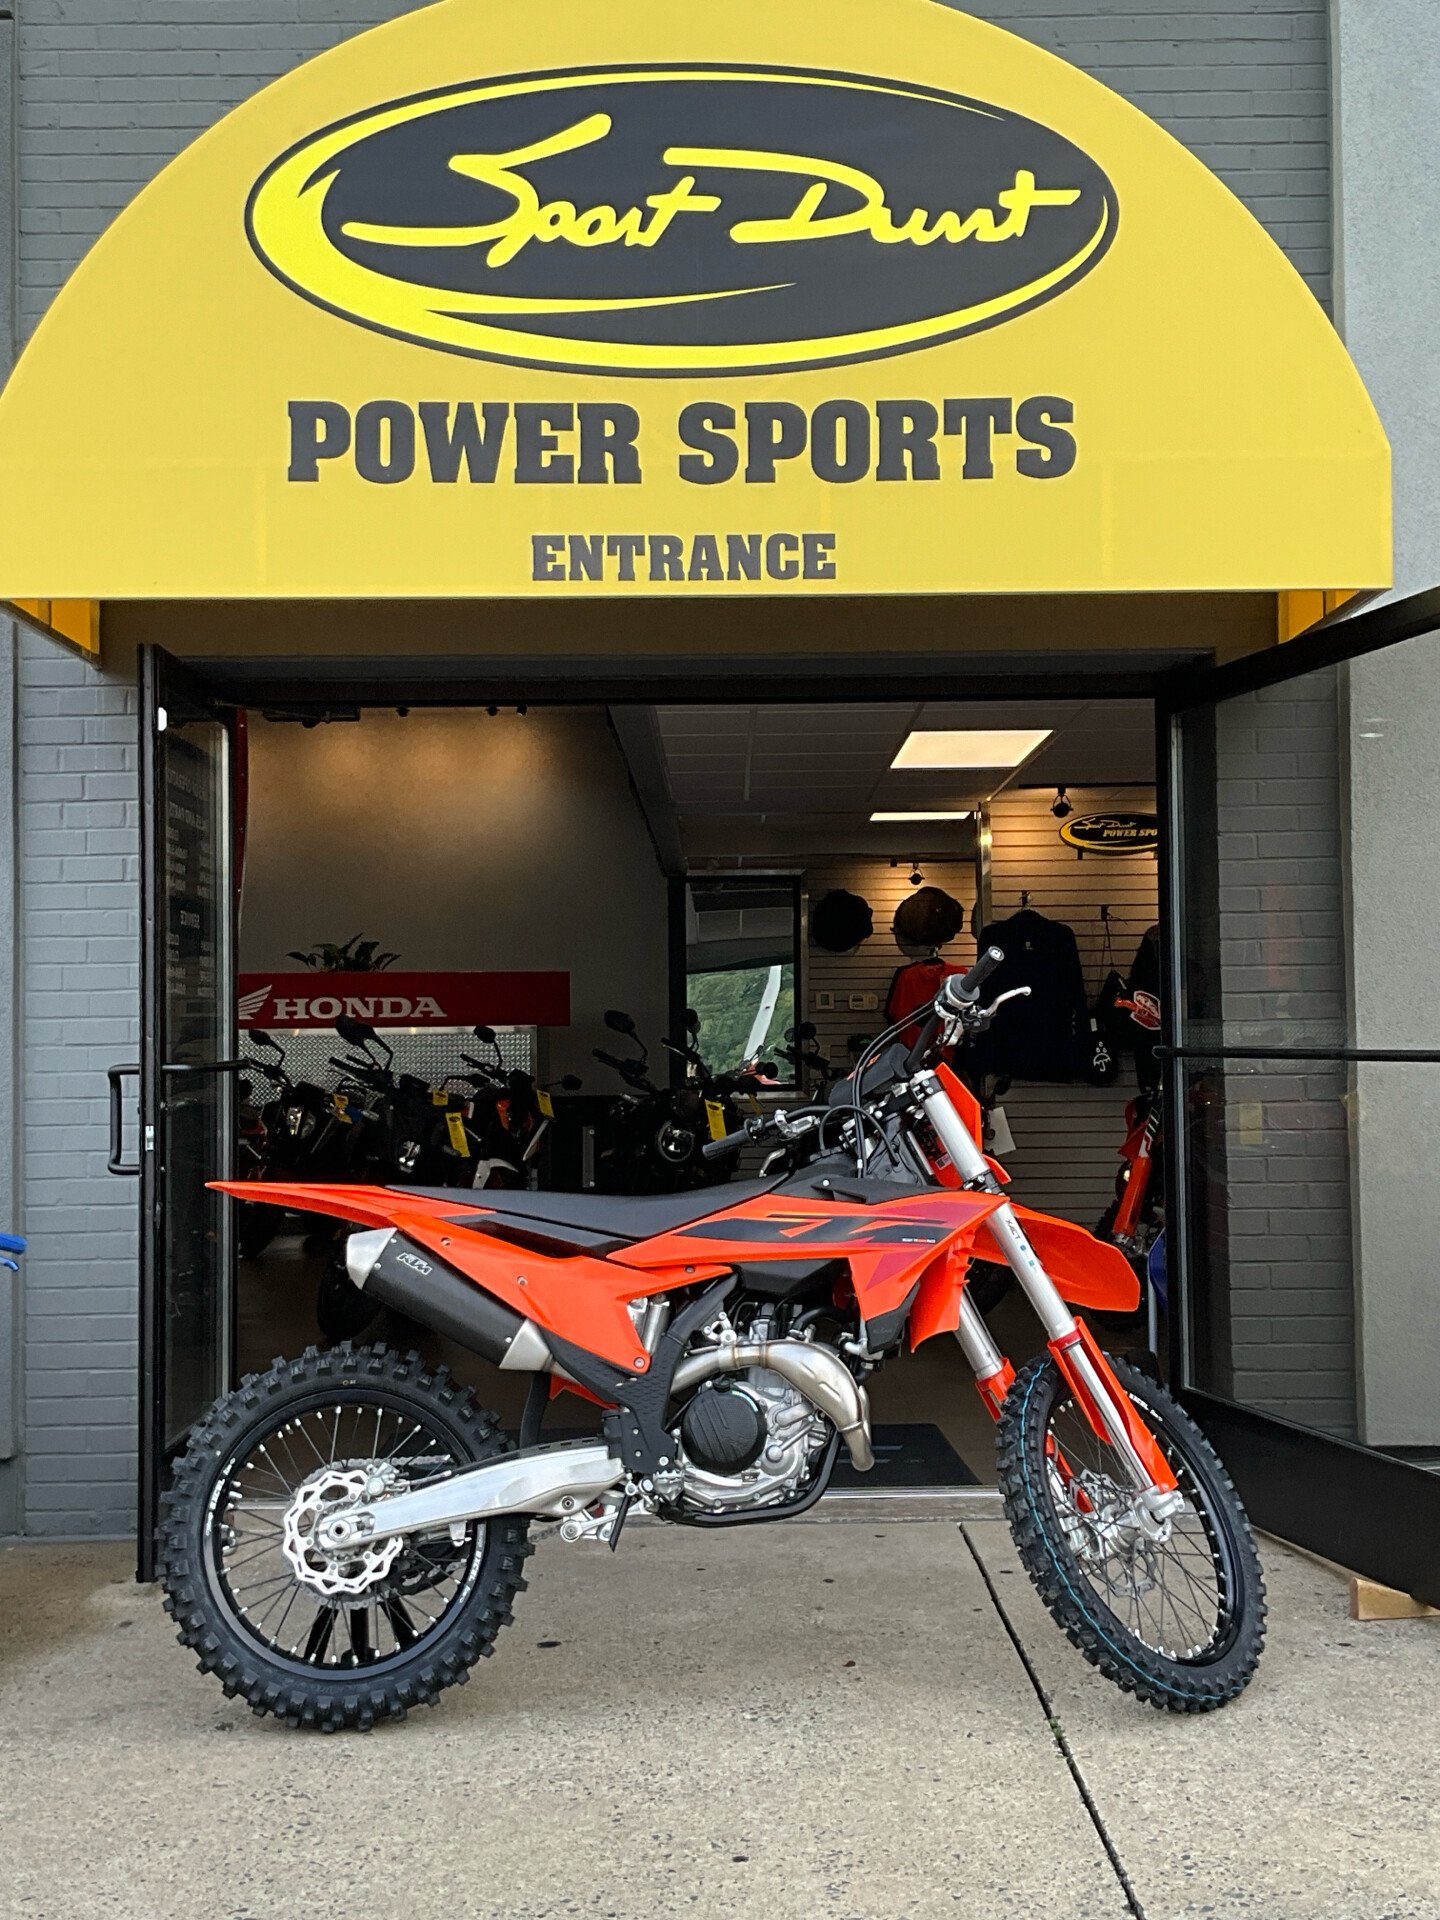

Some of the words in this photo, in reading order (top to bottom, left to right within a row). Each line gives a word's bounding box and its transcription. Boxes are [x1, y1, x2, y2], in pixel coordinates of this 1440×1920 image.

[342, 113, 720, 268] Sport
[288, 401, 641, 484] POWER
[679, 396, 1076, 485] SPORTS
[532, 534, 835, 581] ENTRANCE
[1103, 829, 1137, 837] POWER
[273, 997, 448, 1020] HONDA
[396, 1252, 433, 1275] KTM
